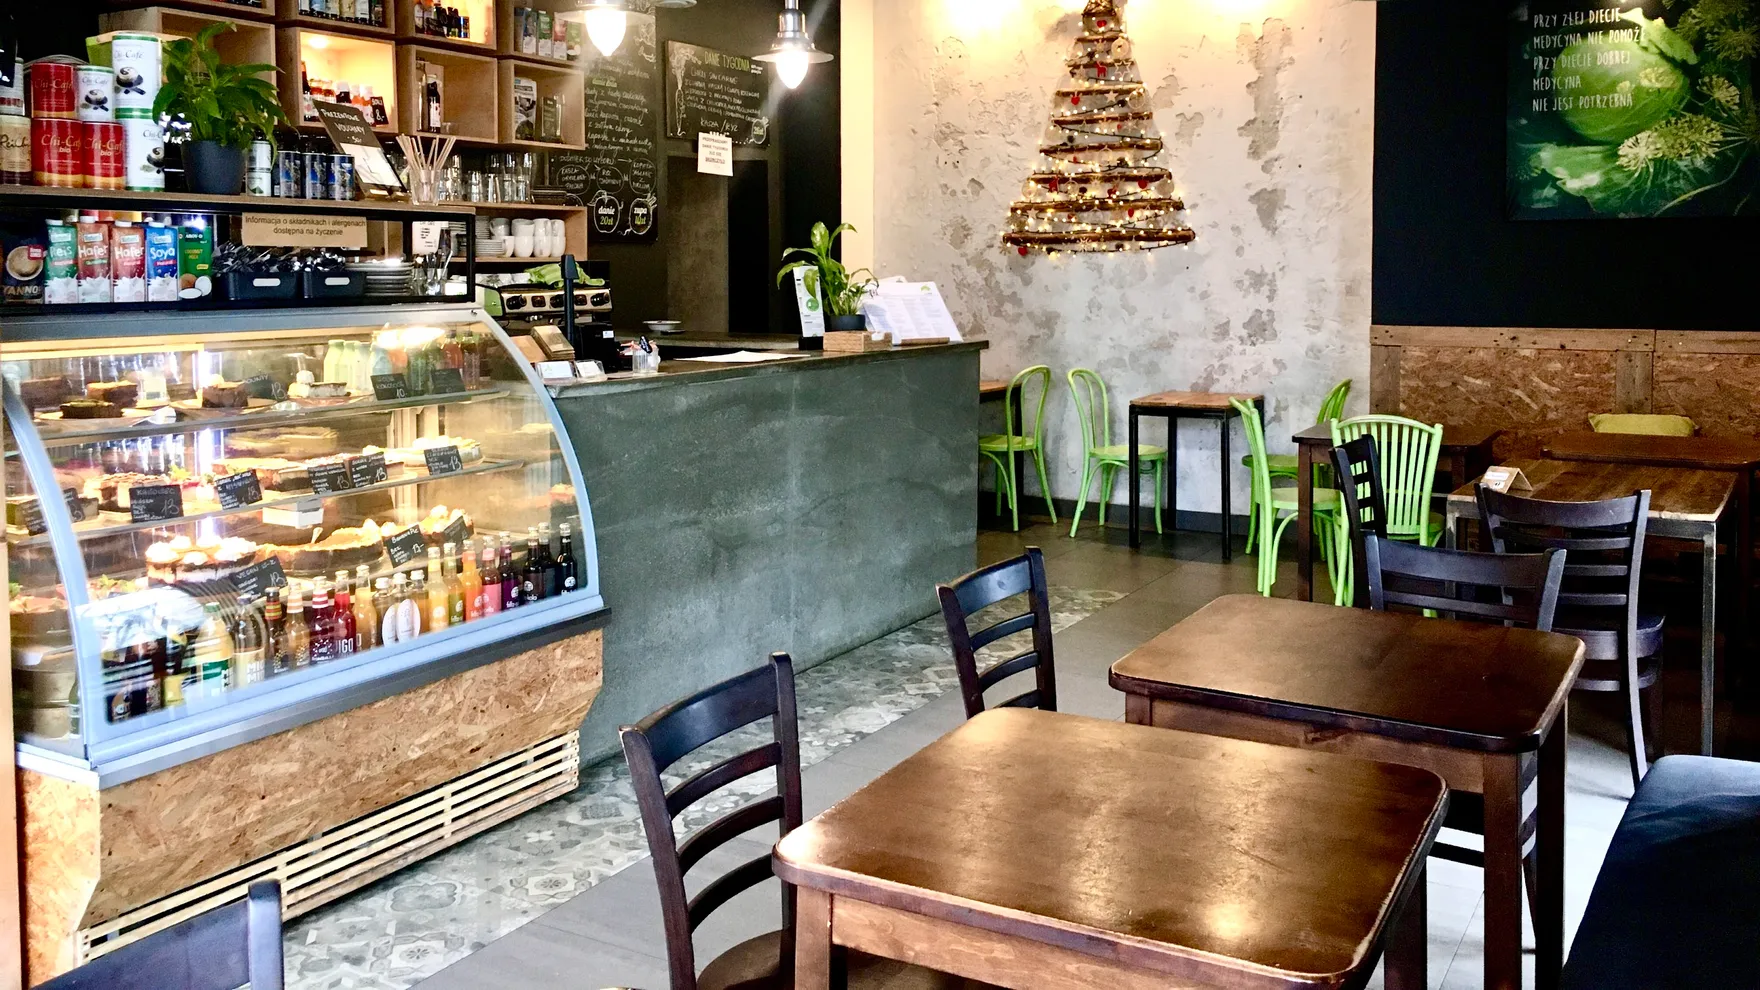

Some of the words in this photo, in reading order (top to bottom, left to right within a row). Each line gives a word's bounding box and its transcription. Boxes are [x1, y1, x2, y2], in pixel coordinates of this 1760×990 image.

[1533, 14, 1557, 28] PRZY
[1562, 11, 1585, 26] ZŁEJ
[1588, 8, 1621, 23] DIECIE
[1533, 32, 1582, 49] MEDYCYNA
[1587, 31, 1604, 45] NIE
[1609, 26, 1646, 44] POMOŻE
[1533, 56, 1556, 70] PRZY
[1561, 52, 1591, 68] DIECIE
[1597, 50, 1631, 67] DOBREJ
[1533, 75, 1582, 91] MEDYCYNA
[1532, 98, 1548, 112] NIE
[1552, 97, 1574, 111] JEST
[1579, 94, 1633, 109] POTRZEBNA
[598, 206, 615, 214] danie
[245, 216, 281, 226] Informacja
[288, 217, 327, 226] składnikach
[331, 219, 366, 227] alergenach
[273, 227, 304, 235] dostępna
[315, 227, 343, 236] życzenie
[49, 246, 73, 258] Reis
[78, 244, 108, 259] Hafer
[114, 246, 144, 260] Hafer
[150, 247, 176, 260] Soya
